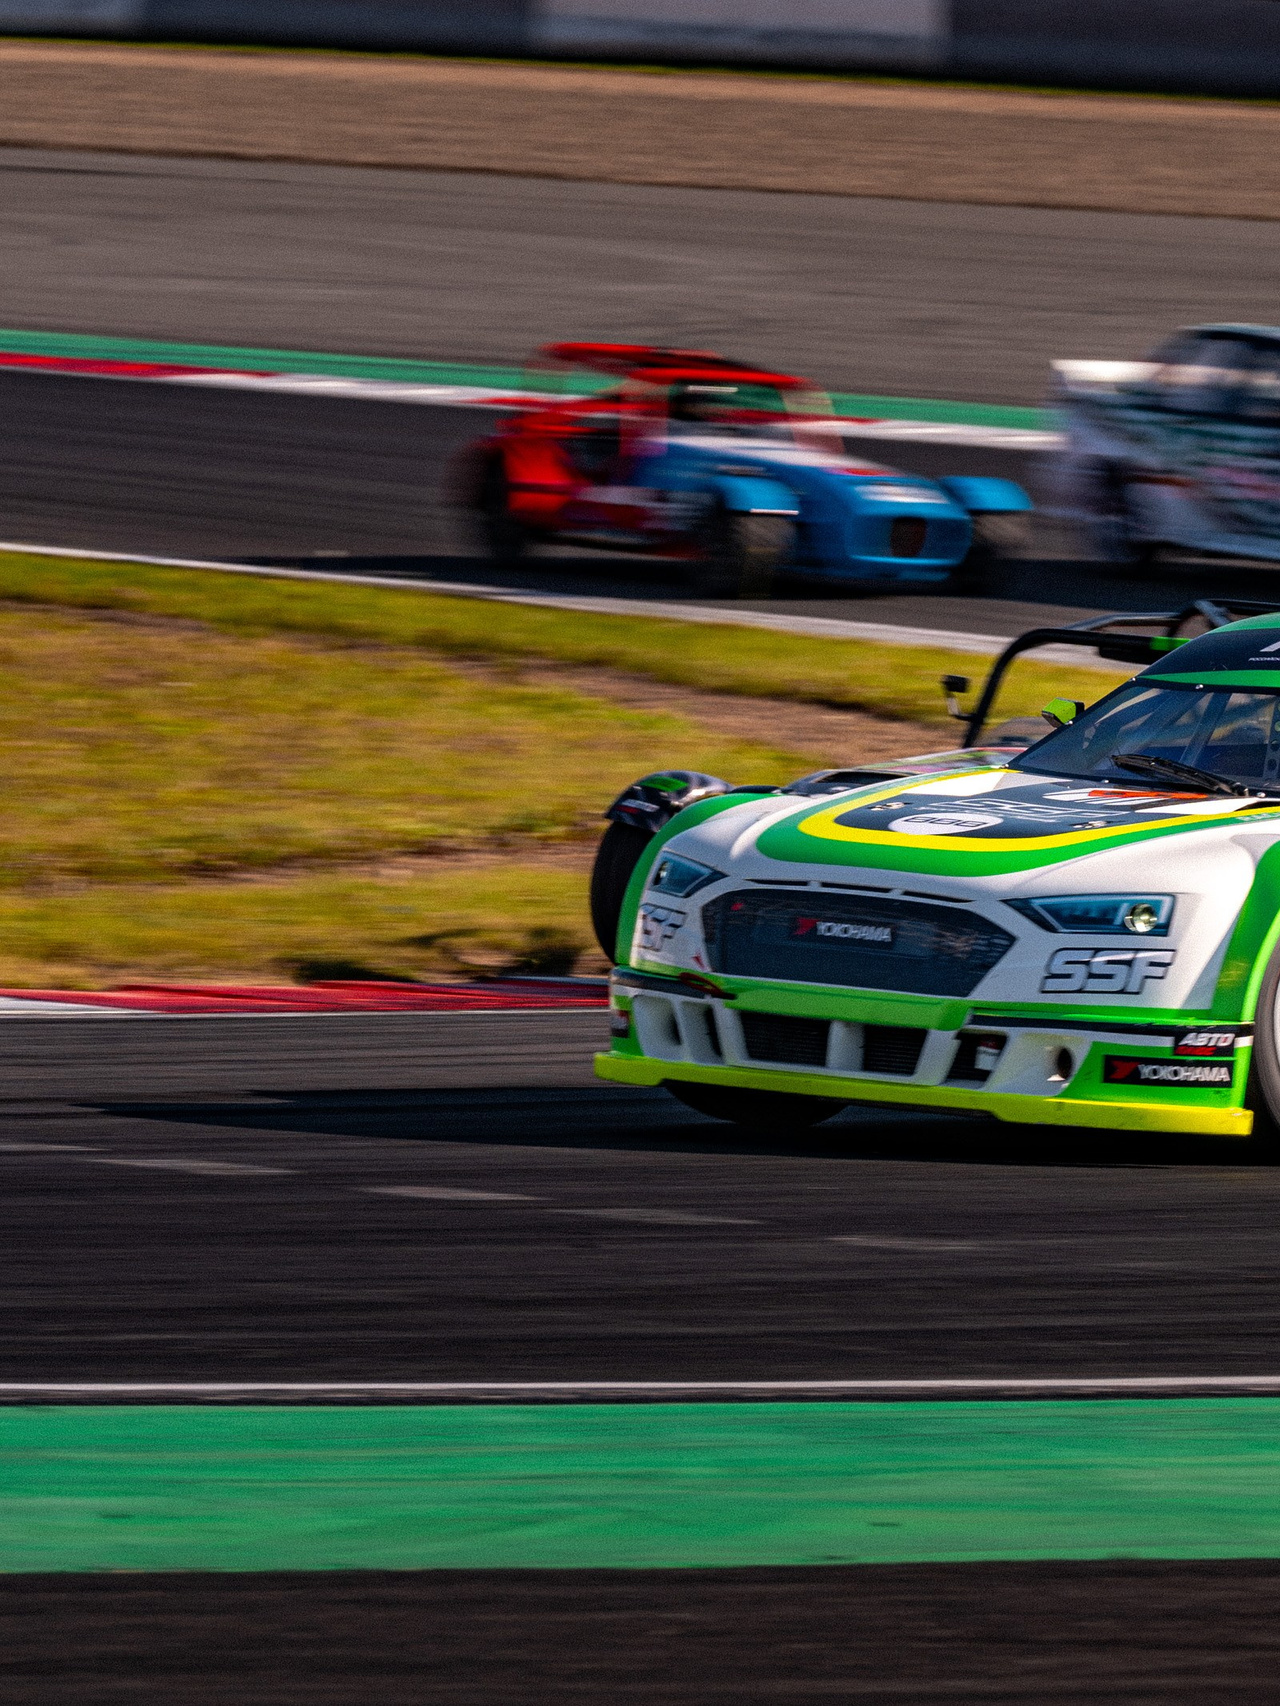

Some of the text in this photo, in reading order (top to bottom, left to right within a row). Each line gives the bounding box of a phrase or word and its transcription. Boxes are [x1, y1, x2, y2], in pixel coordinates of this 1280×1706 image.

[816, 921, 893, 943] YOKOHAMA
[1039, 947, 1177, 995] SSF
[1138, 1064, 1231, 1082] YOKOHAMA
